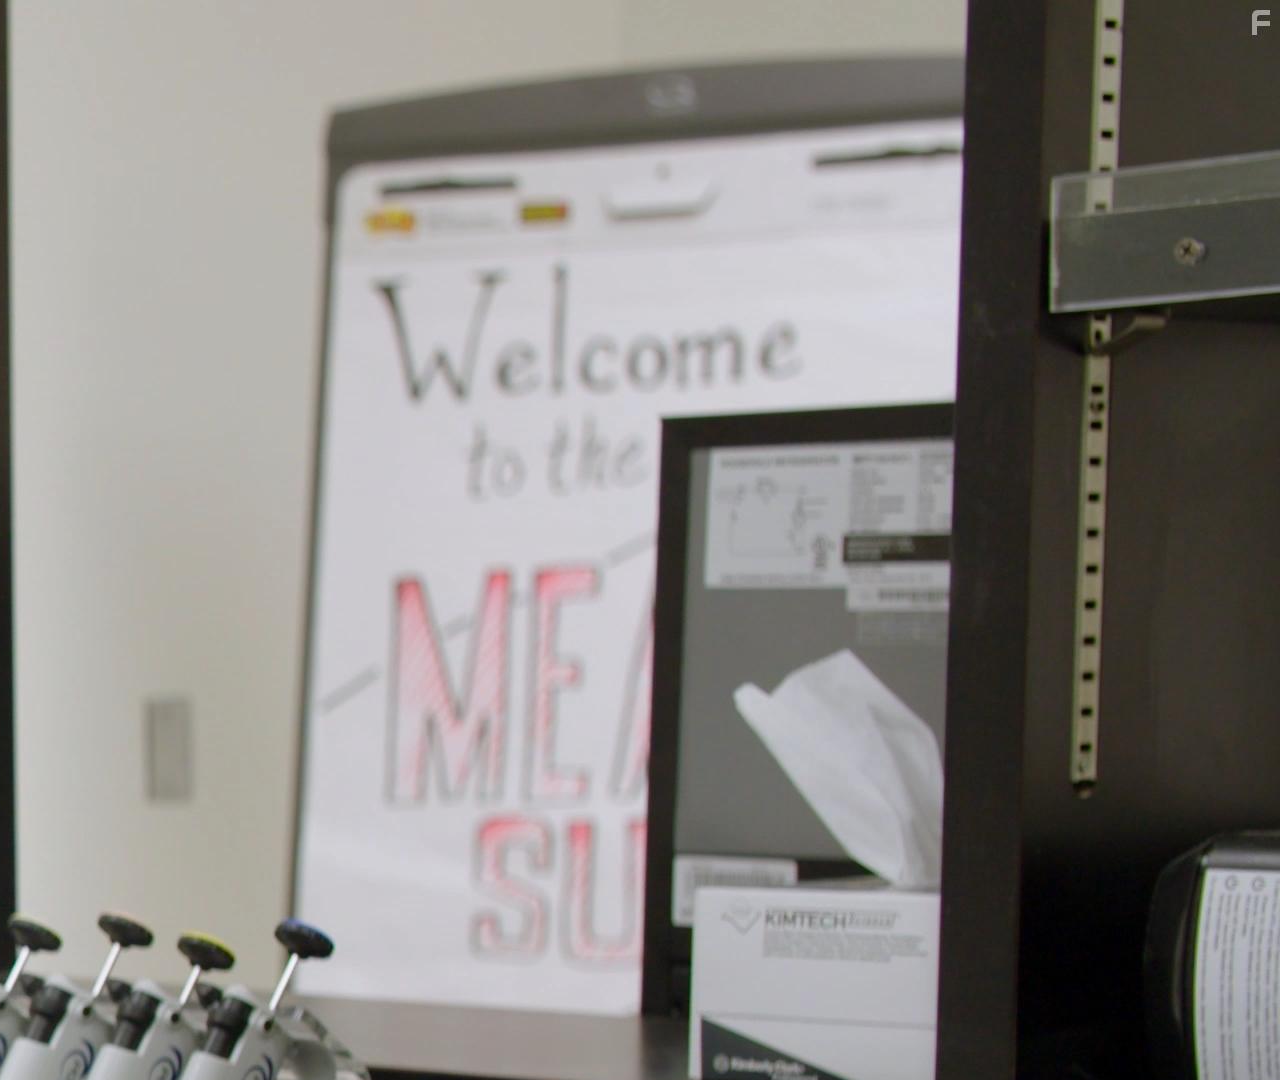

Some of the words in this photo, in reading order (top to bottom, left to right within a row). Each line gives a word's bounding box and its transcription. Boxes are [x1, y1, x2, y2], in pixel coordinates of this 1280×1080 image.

[372, 262, 801, 404] Welcome
[466, 422, 528, 502] to
[547, 412, 648, 496] the
[765, 910, 847, 929] KIMTECH
